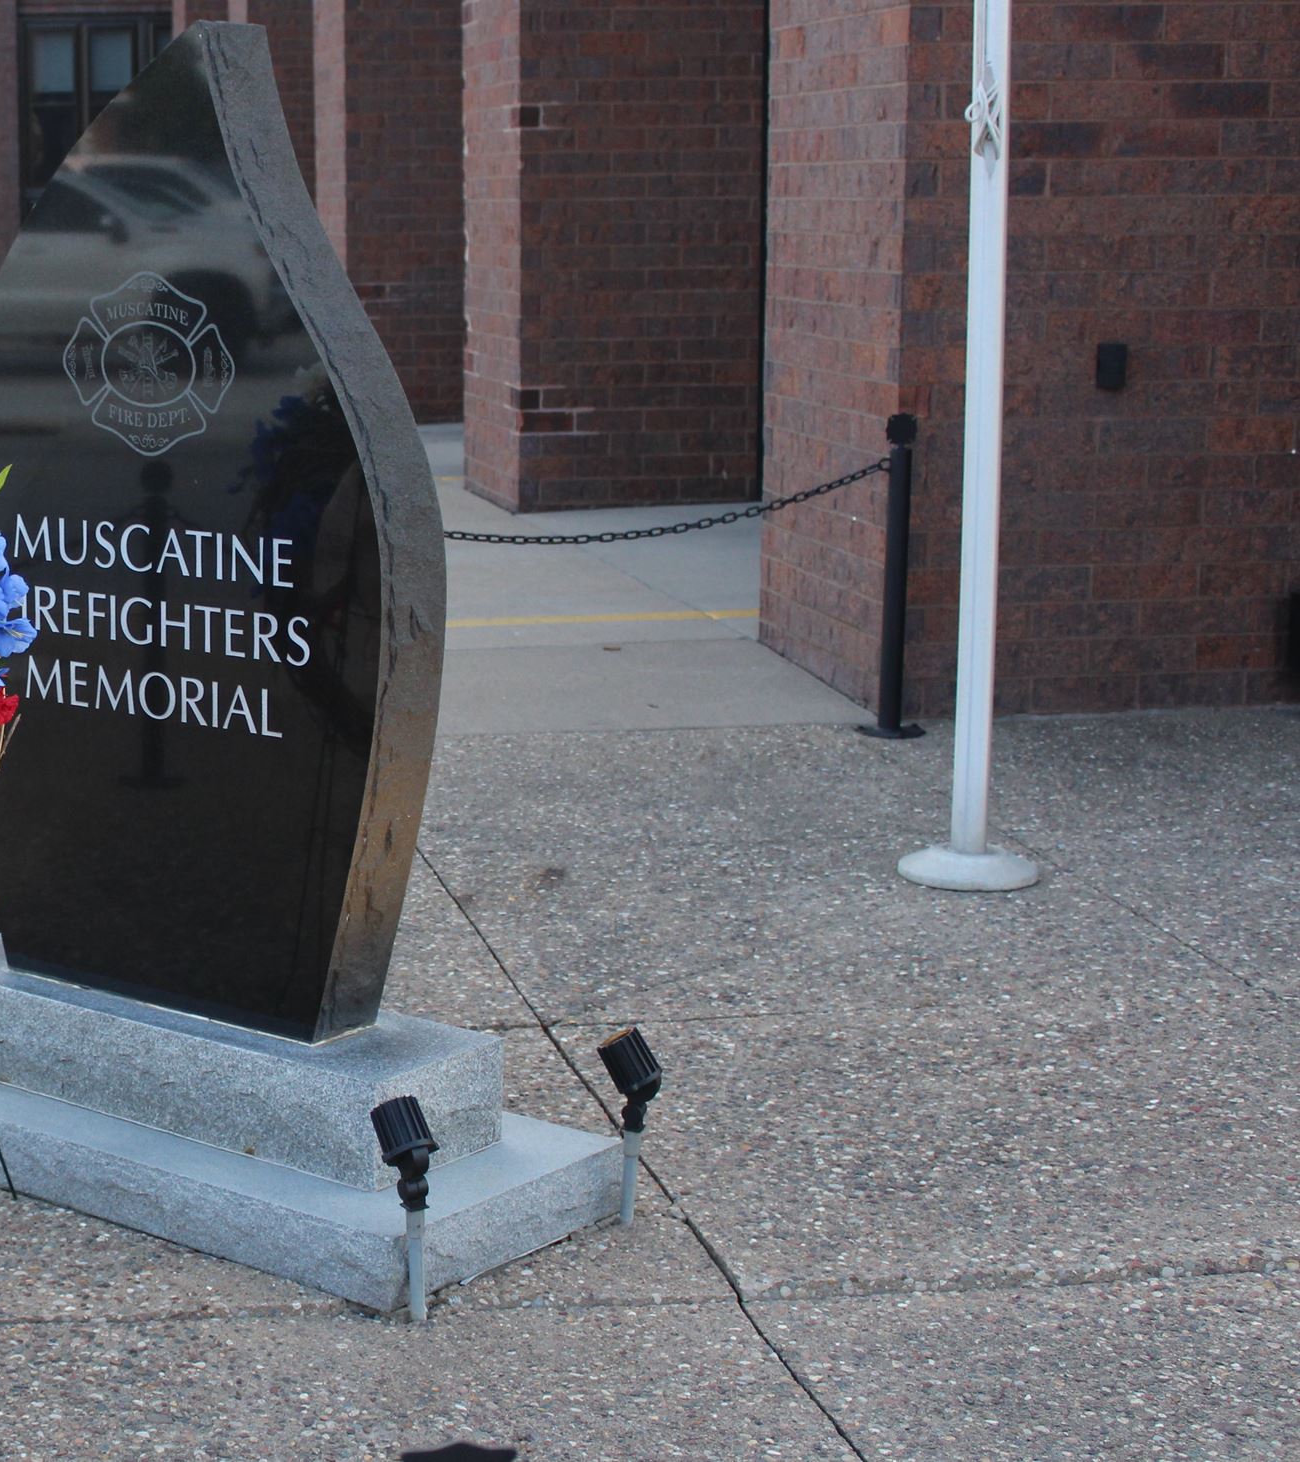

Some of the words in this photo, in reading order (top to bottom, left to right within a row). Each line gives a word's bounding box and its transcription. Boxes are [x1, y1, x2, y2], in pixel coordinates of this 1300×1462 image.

[106, 302, 189, 326] MUSCATINE
[108, 403, 143, 427] FIRE
[147, 407, 191, 428] DEPT.
[13, 513, 295, 588] MUSCATINE
[21, 585, 311, 667] IREFIGHTERS
[25, 654, 283, 738] MEMORIAL
